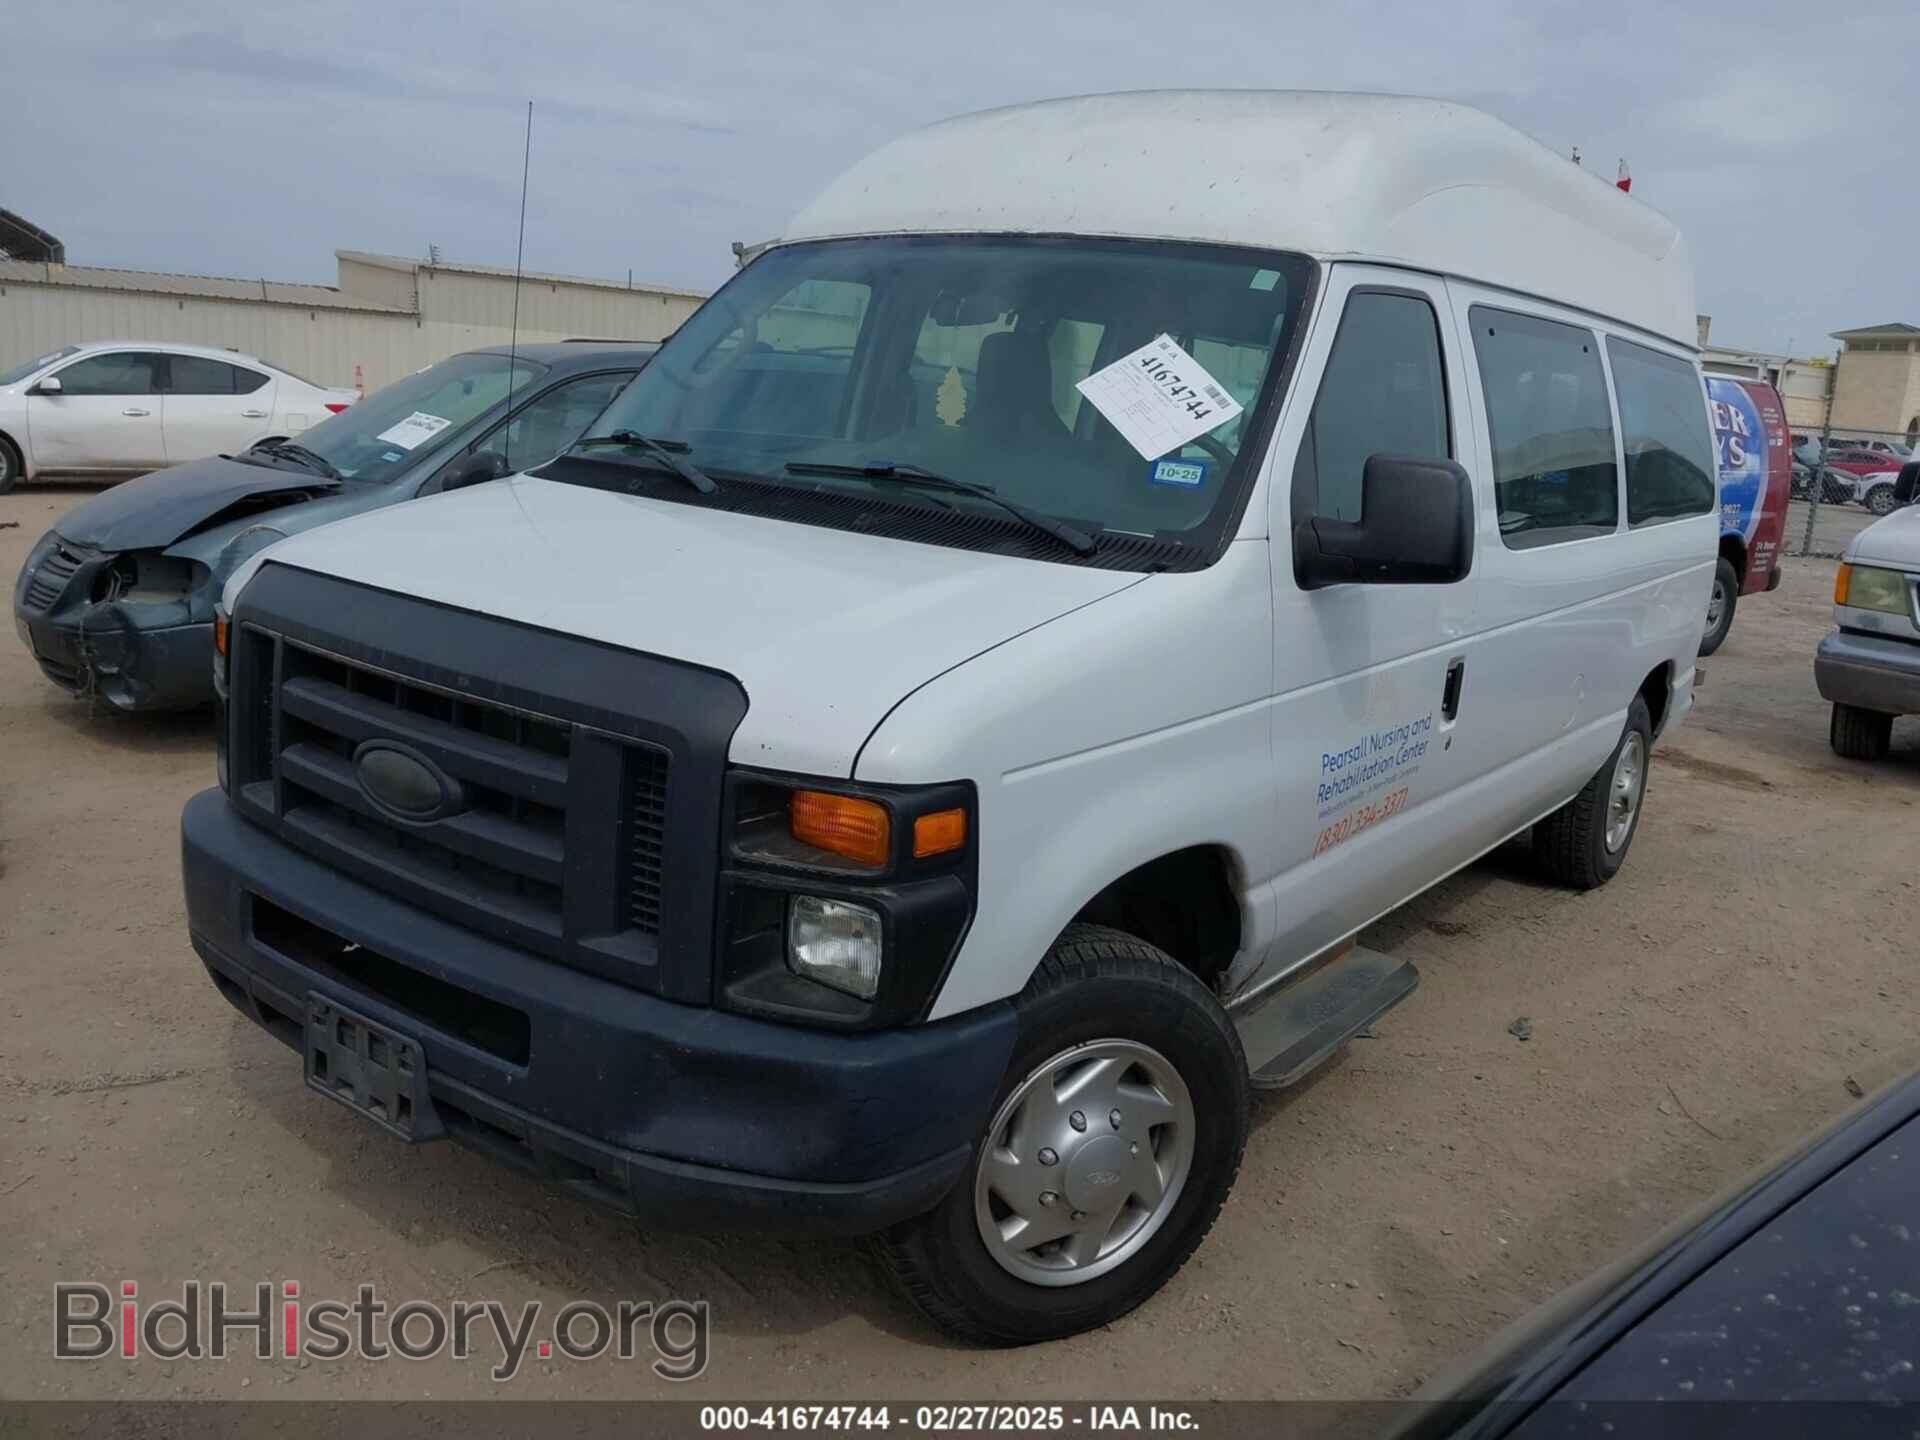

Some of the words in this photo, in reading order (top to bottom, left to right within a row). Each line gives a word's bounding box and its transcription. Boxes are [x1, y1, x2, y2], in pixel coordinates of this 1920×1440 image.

[1140, 356, 1213, 420] 41674744
[1160, 467, 1200, 480] 10-25
[1317, 756, 1395, 805] Rehabilitation
[1395, 740, 1430, 766] Center
[1321, 736, 1367, 776] Pearsall
[1370, 724, 1410, 752] Nursing
[1411, 711, 1433, 736] and
[1312, 815, 1353, 860] (830)
[1352, 786, 1409, 835] 334-3377
